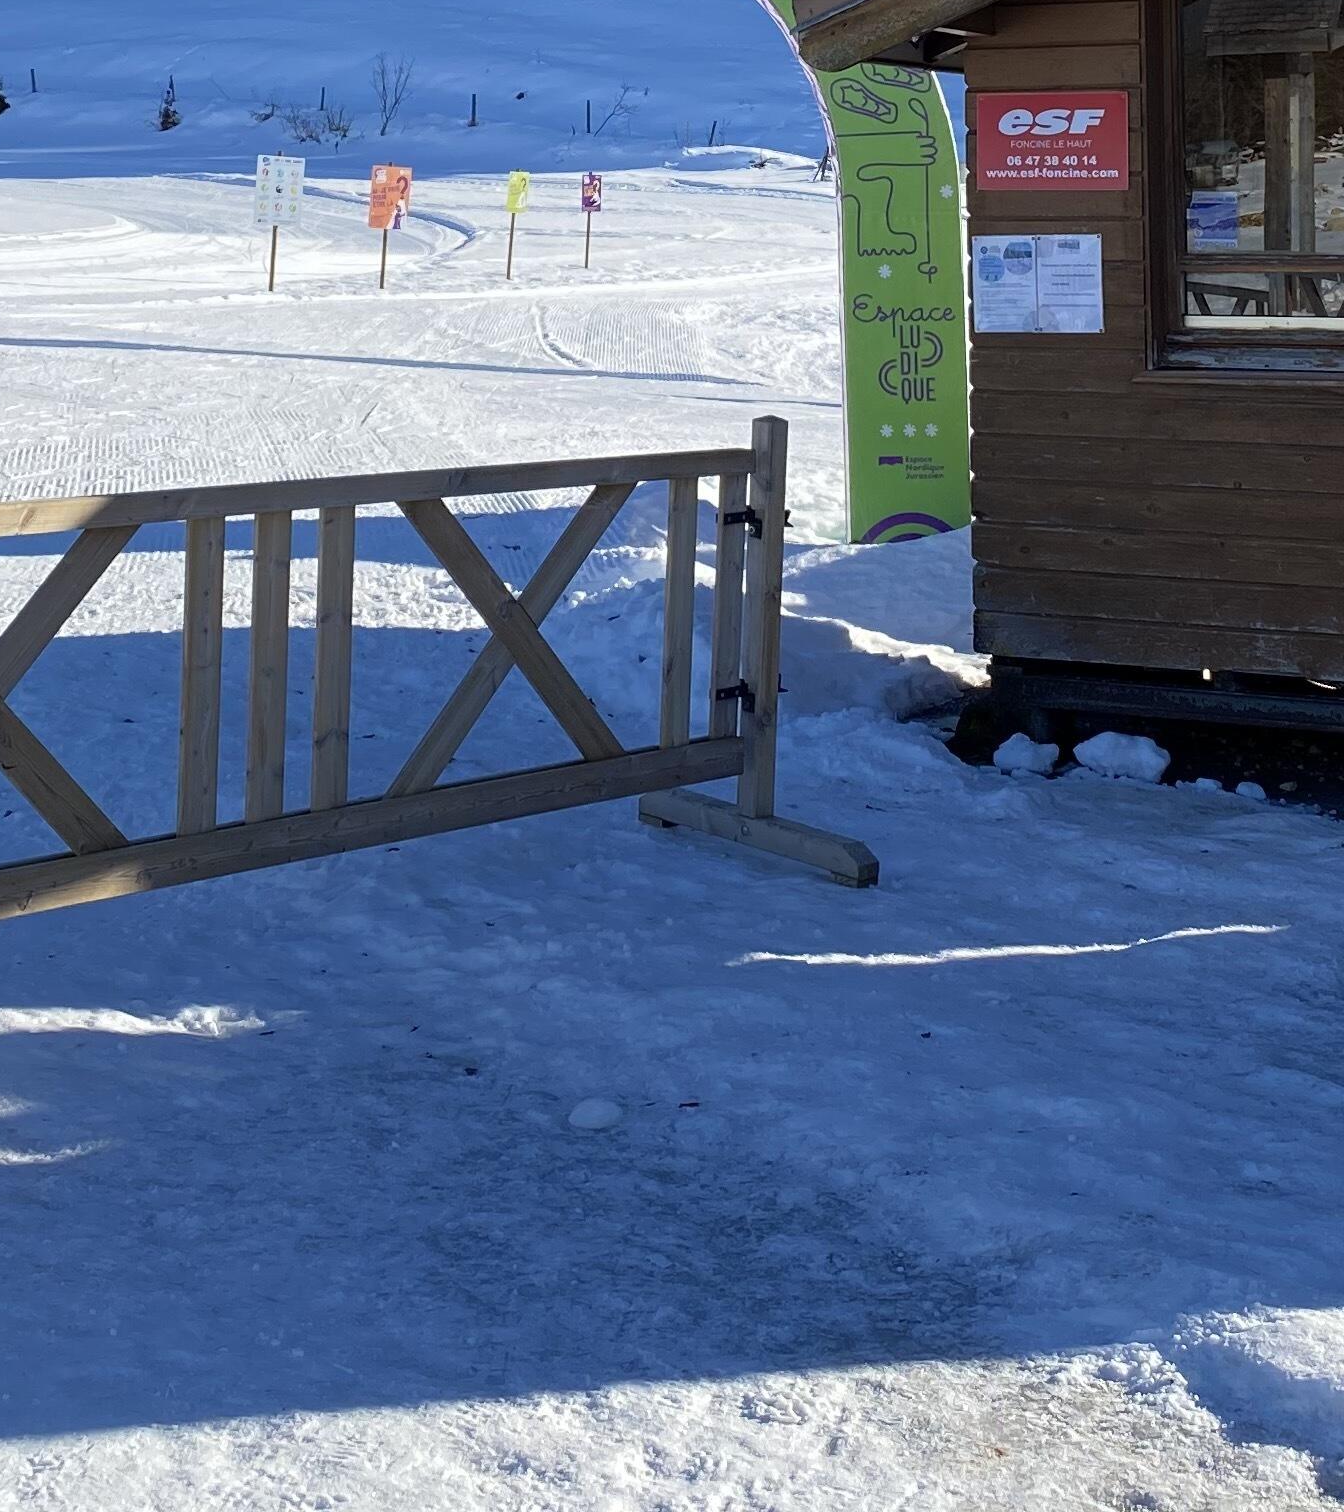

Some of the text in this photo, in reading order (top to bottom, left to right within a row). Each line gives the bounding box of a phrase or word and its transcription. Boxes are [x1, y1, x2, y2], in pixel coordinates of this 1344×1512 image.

[1010, 139, 1092, 149] FONCINE LE HAUT
[1007, 156, 1097, 166] 06 47 38 40 14
[986, 167, 1119, 179] www.esf-foncine.com
[853, 294, 956, 337] Espace
